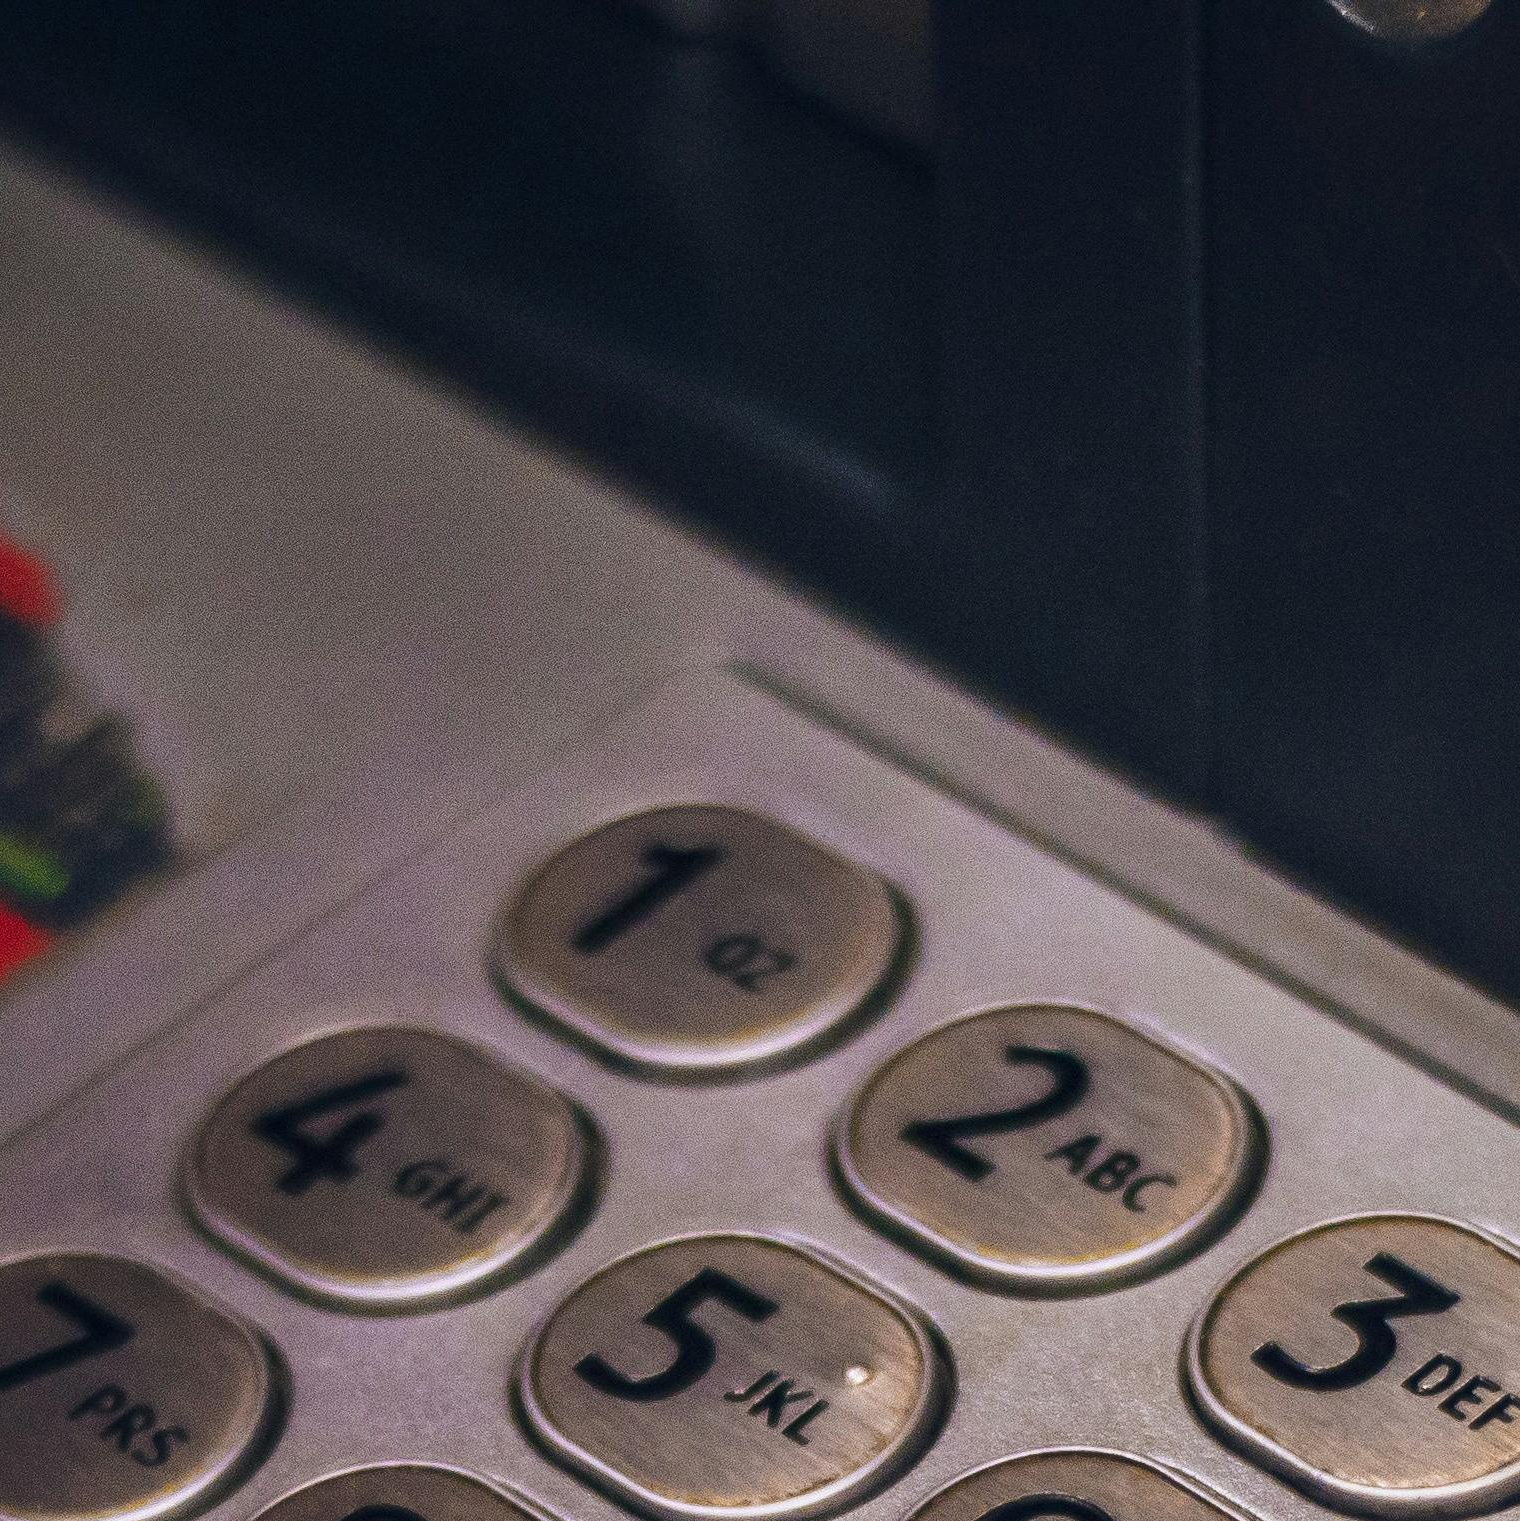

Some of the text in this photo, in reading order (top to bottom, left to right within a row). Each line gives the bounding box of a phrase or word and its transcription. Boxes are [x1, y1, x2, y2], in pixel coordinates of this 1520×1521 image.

[573, 842, 725, 954] 1
[251, 1065, 511, 1233] 4 GHI
[901, 1045, 1178, 1213] 2 ABC
[574, 1267, 830, 1445] 5 JKL
[1250, 1251, 1461, 1392] 3
[69, 1382, 190, 1467] PRS
